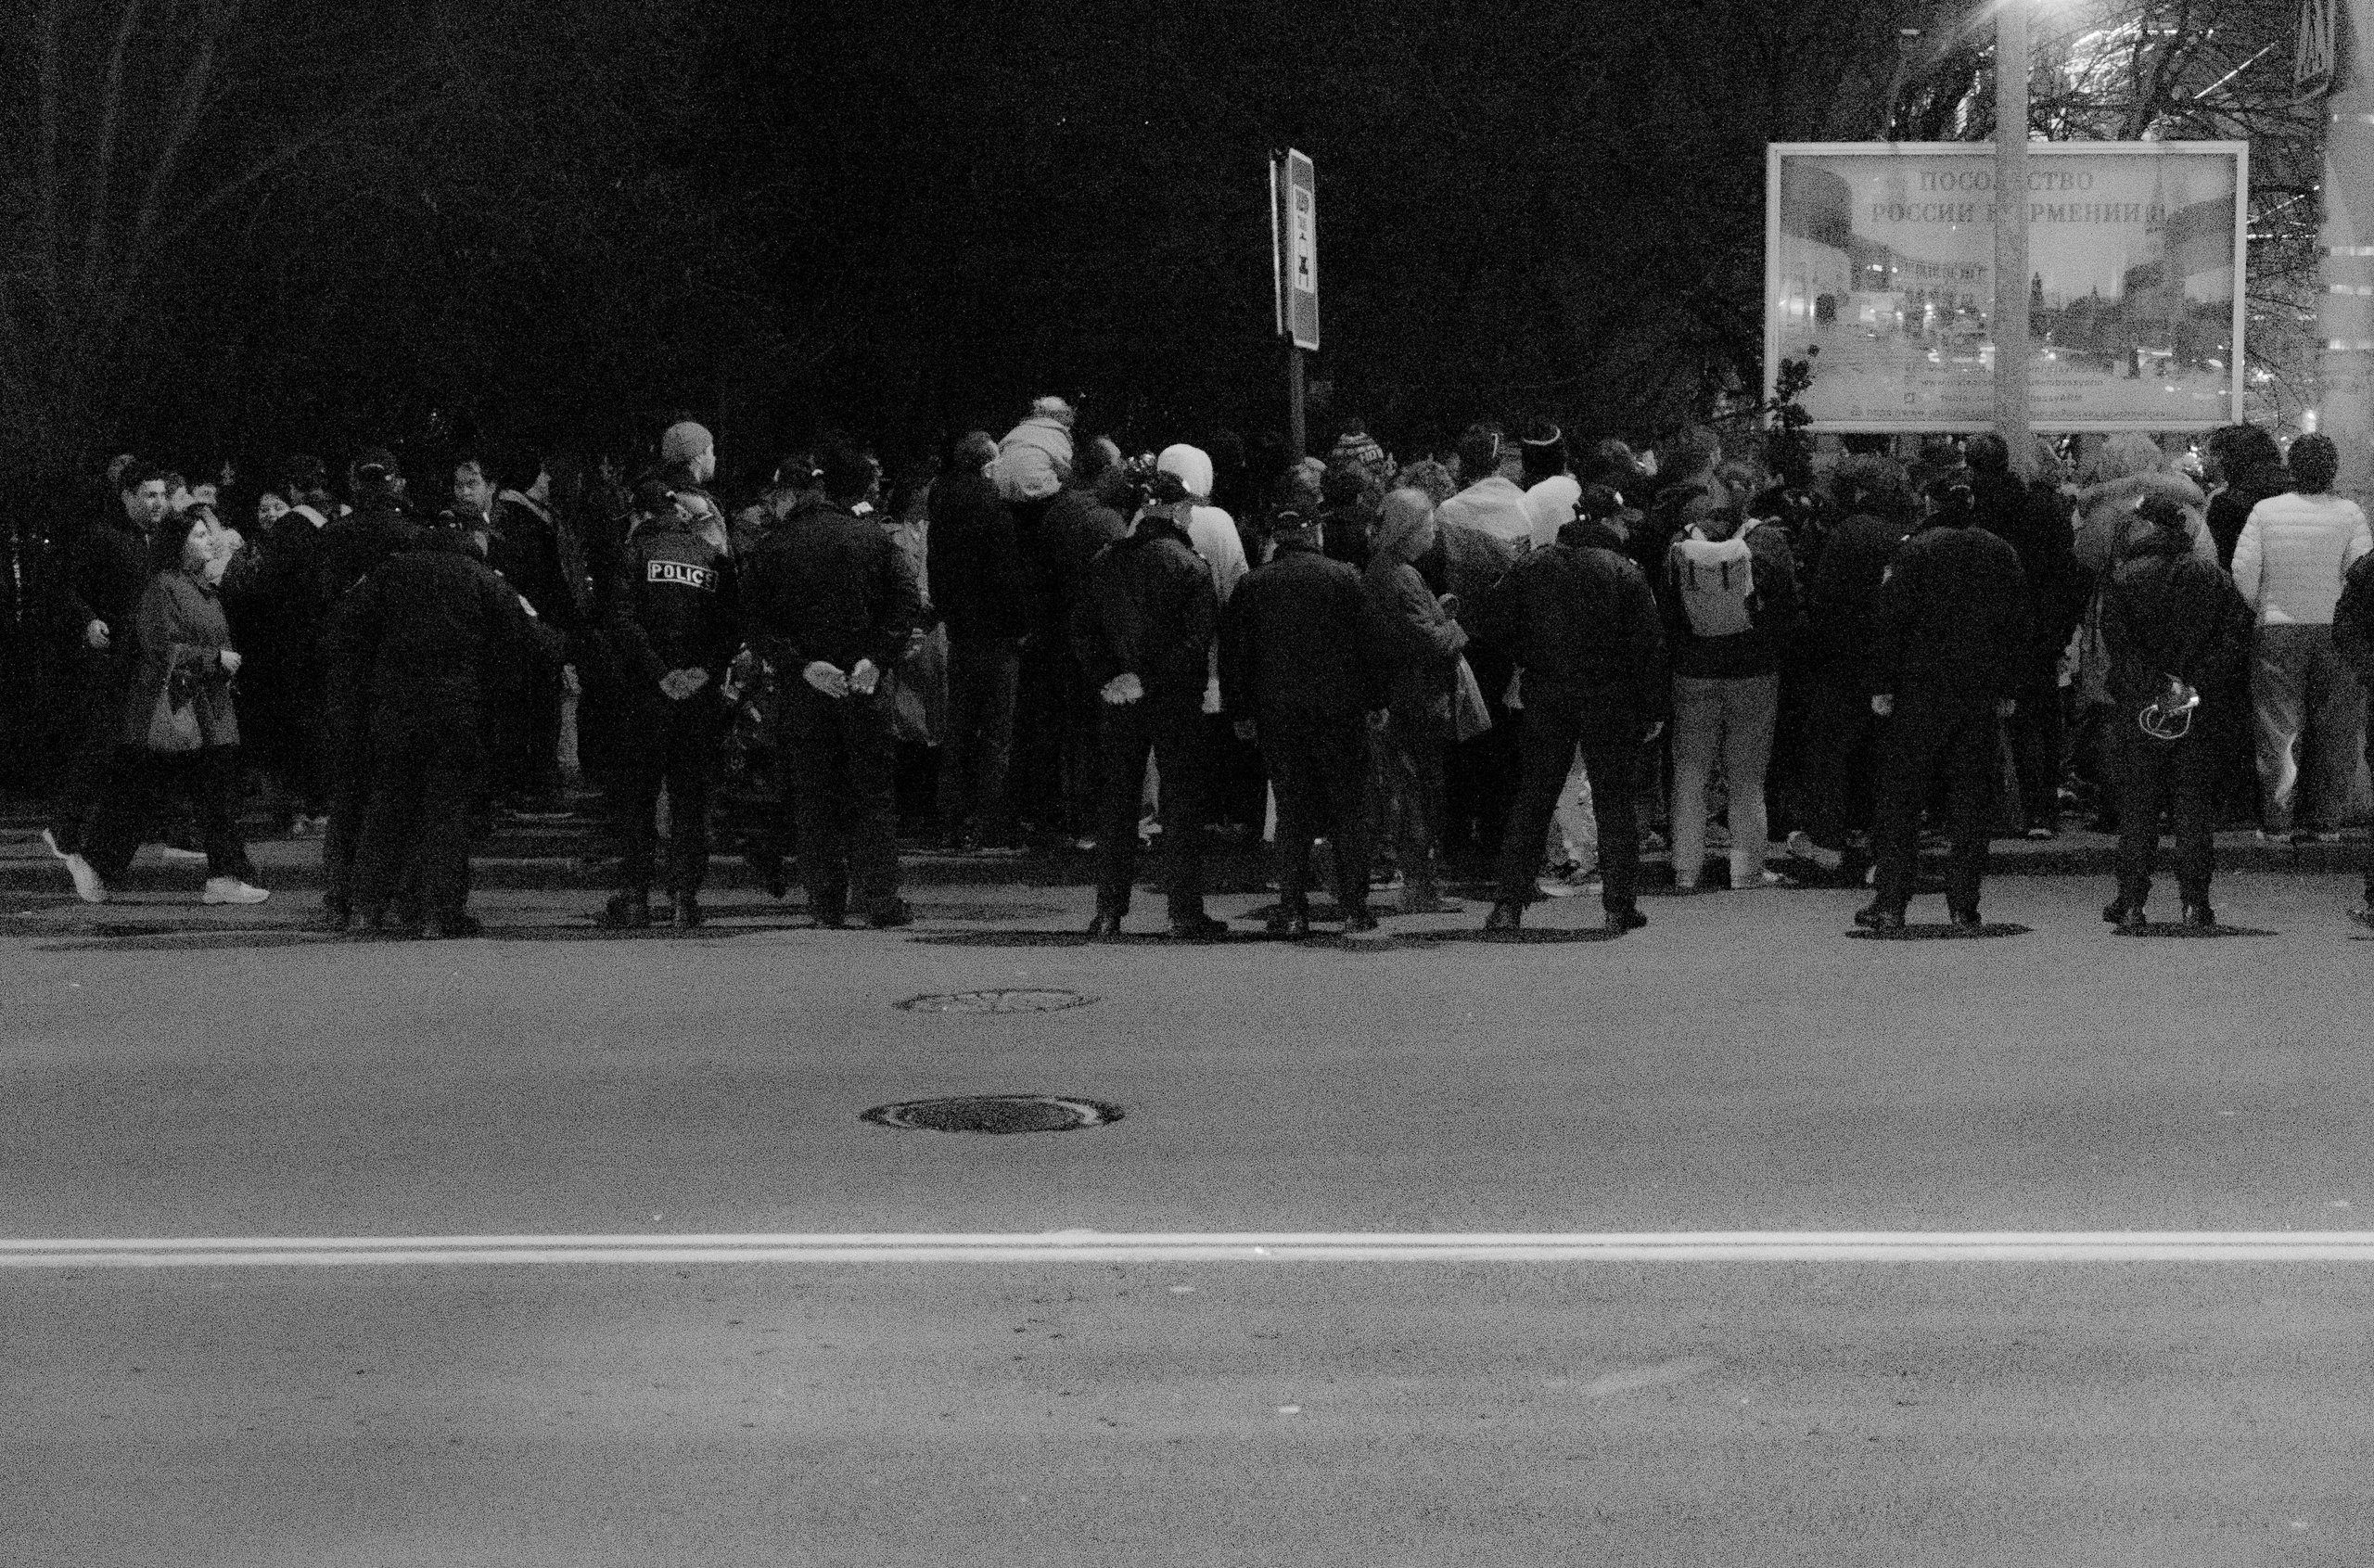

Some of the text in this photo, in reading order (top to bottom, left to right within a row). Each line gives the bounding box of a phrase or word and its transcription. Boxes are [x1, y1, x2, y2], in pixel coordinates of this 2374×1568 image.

[1920, 171, 2095, 191] ПОСОСТВО
[1870, 202, 1973, 223] РОССИИ
[2013, 202, 2141, 223] РМЕНИИ
